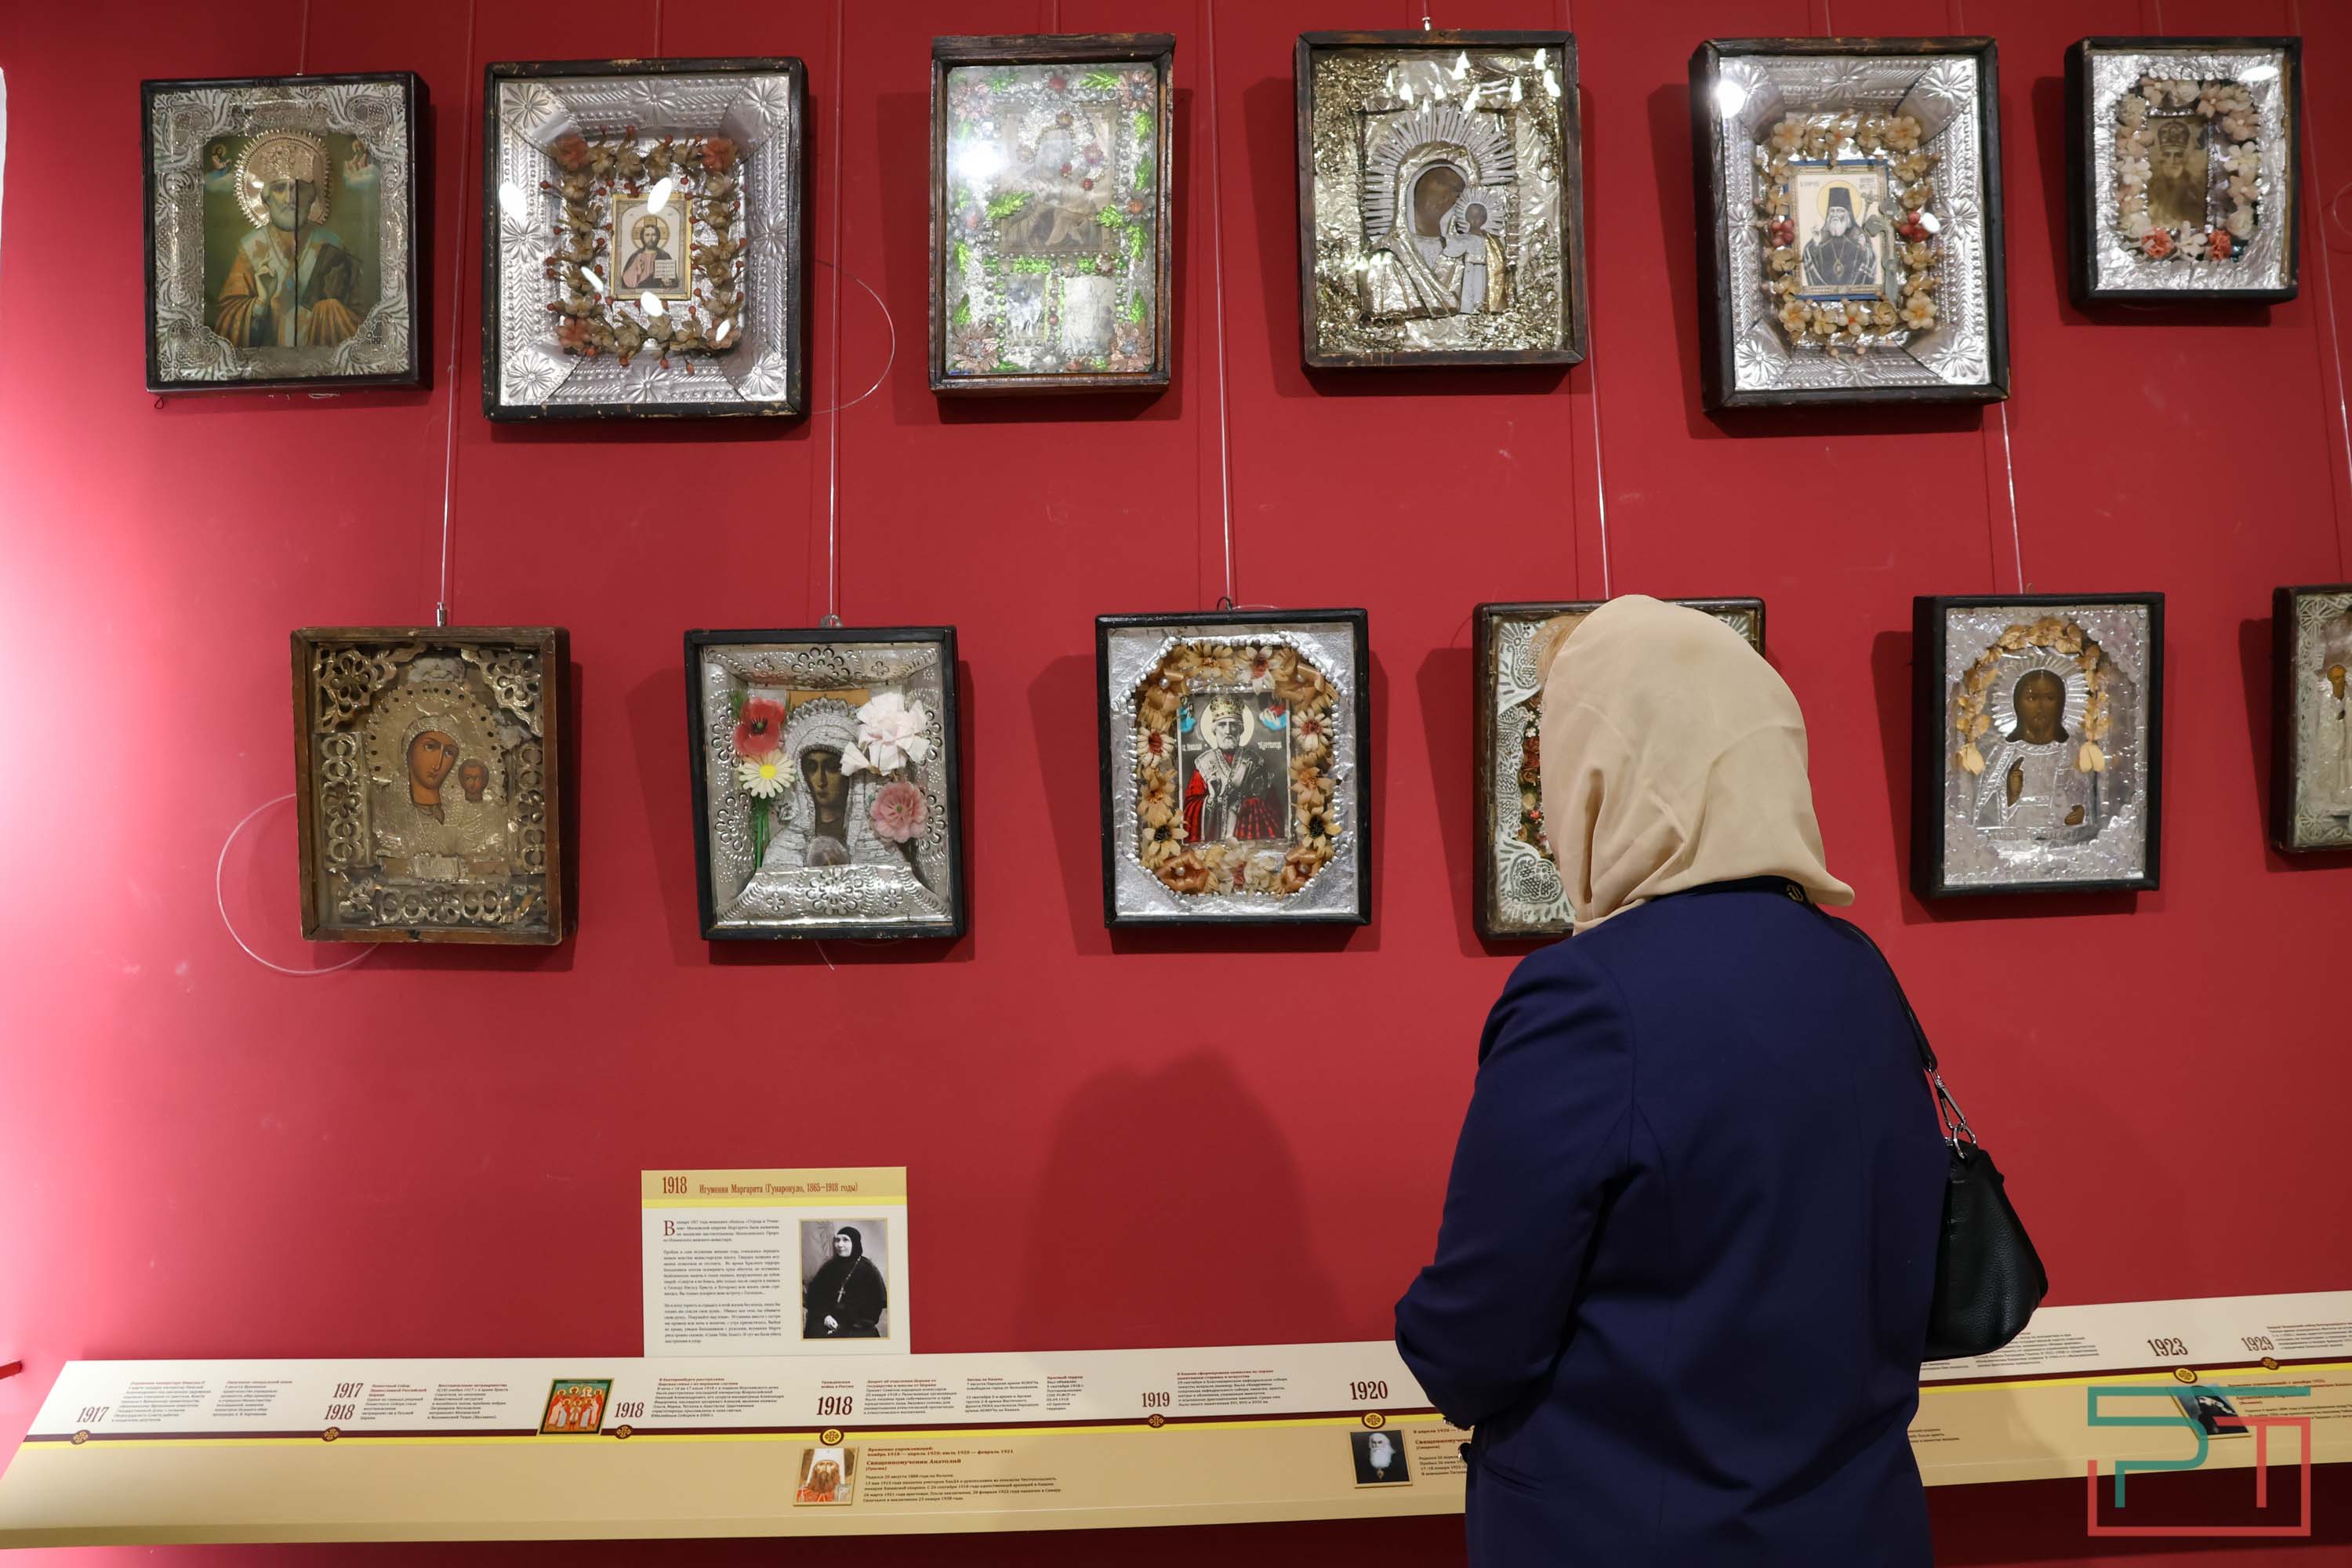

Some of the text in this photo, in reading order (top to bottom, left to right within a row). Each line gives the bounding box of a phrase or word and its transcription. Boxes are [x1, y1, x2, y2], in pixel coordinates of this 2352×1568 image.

[662, 1176, 688, 1194] 1918
[731, 1183, 763, 1195] Маргарита
[840, 1182, 858, 1193] годы)
[663, 1220, 675, 1236] В
[2147, 1338, 2188, 1357] 1923
[2241, 1336, 2274, 1352] 1929
[333, 1382, 365, 1399] 1917
[1349, 1381, 1388, 1400] 1920
[816, 1396, 853, 1416] 1918
[1142, 1392, 1171, 1408] 1919
[75, 1406, 110, 1423] 1917
[324, 1404, 356, 1421] 1918
[615, 1402, 644, 1418] 1918
